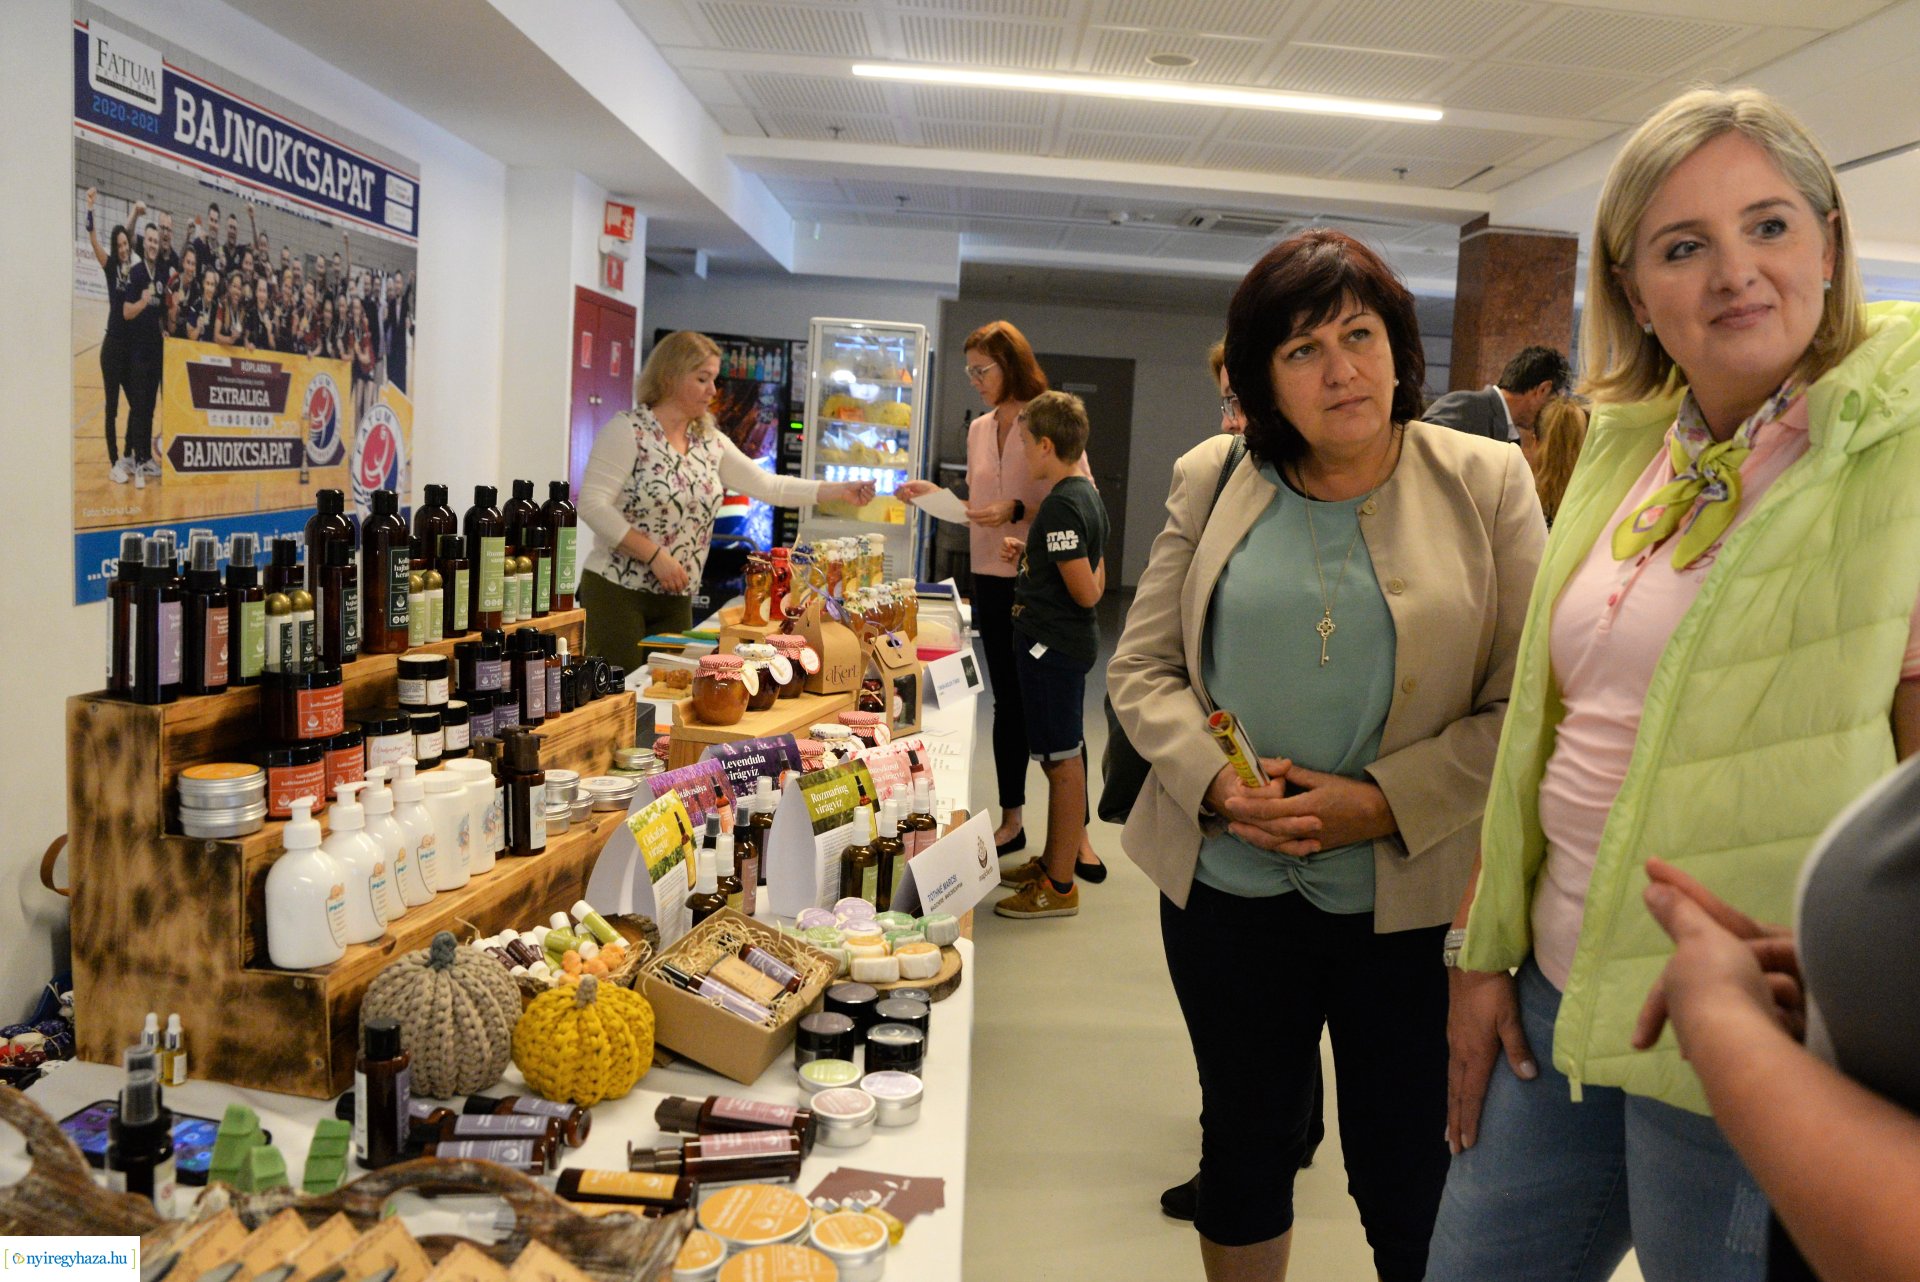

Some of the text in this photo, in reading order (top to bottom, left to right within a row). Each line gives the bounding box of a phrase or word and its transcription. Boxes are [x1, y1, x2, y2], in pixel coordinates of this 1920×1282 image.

[96, 37, 156, 90] FATUM
[93, 95, 159, 134] 2020-2021
[174, 86, 376, 213] BAJNOKCSAPAT
[209, 386, 271, 407] EXTRALIGA
[183, 441, 293, 467] BAJNOKCSAPAT
[810, 782, 850, 804] Rozmaring
[814, 797, 844, 816] virágvíz
